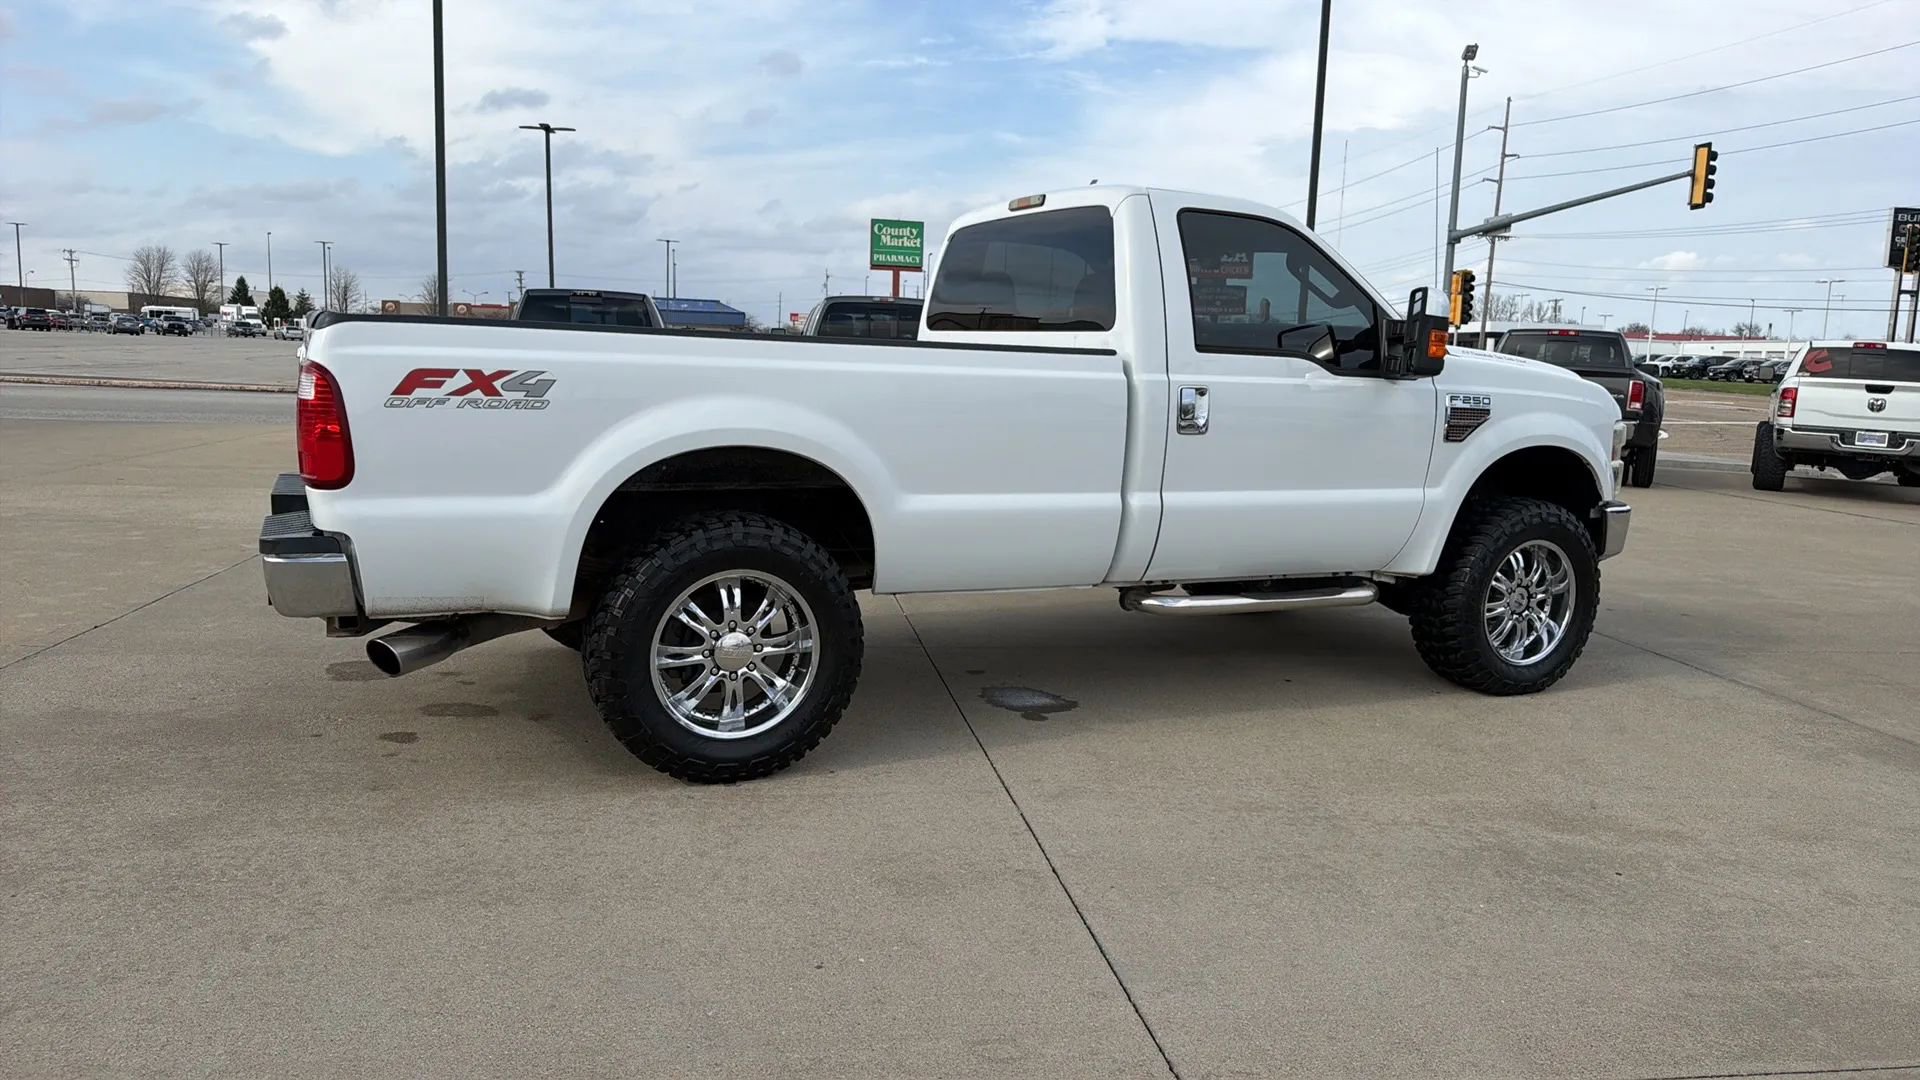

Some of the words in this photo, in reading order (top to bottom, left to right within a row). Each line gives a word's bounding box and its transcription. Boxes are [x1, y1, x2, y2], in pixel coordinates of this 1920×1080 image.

[873, 223, 919, 237] County
[880, 235, 921, 247] Market
[873, 253, 920, 263] PHARMACY
[390, 368, 557, 398] FX4
[384, 397, 450, 409] OFF
[456, 398, 551, 410] ROAD
